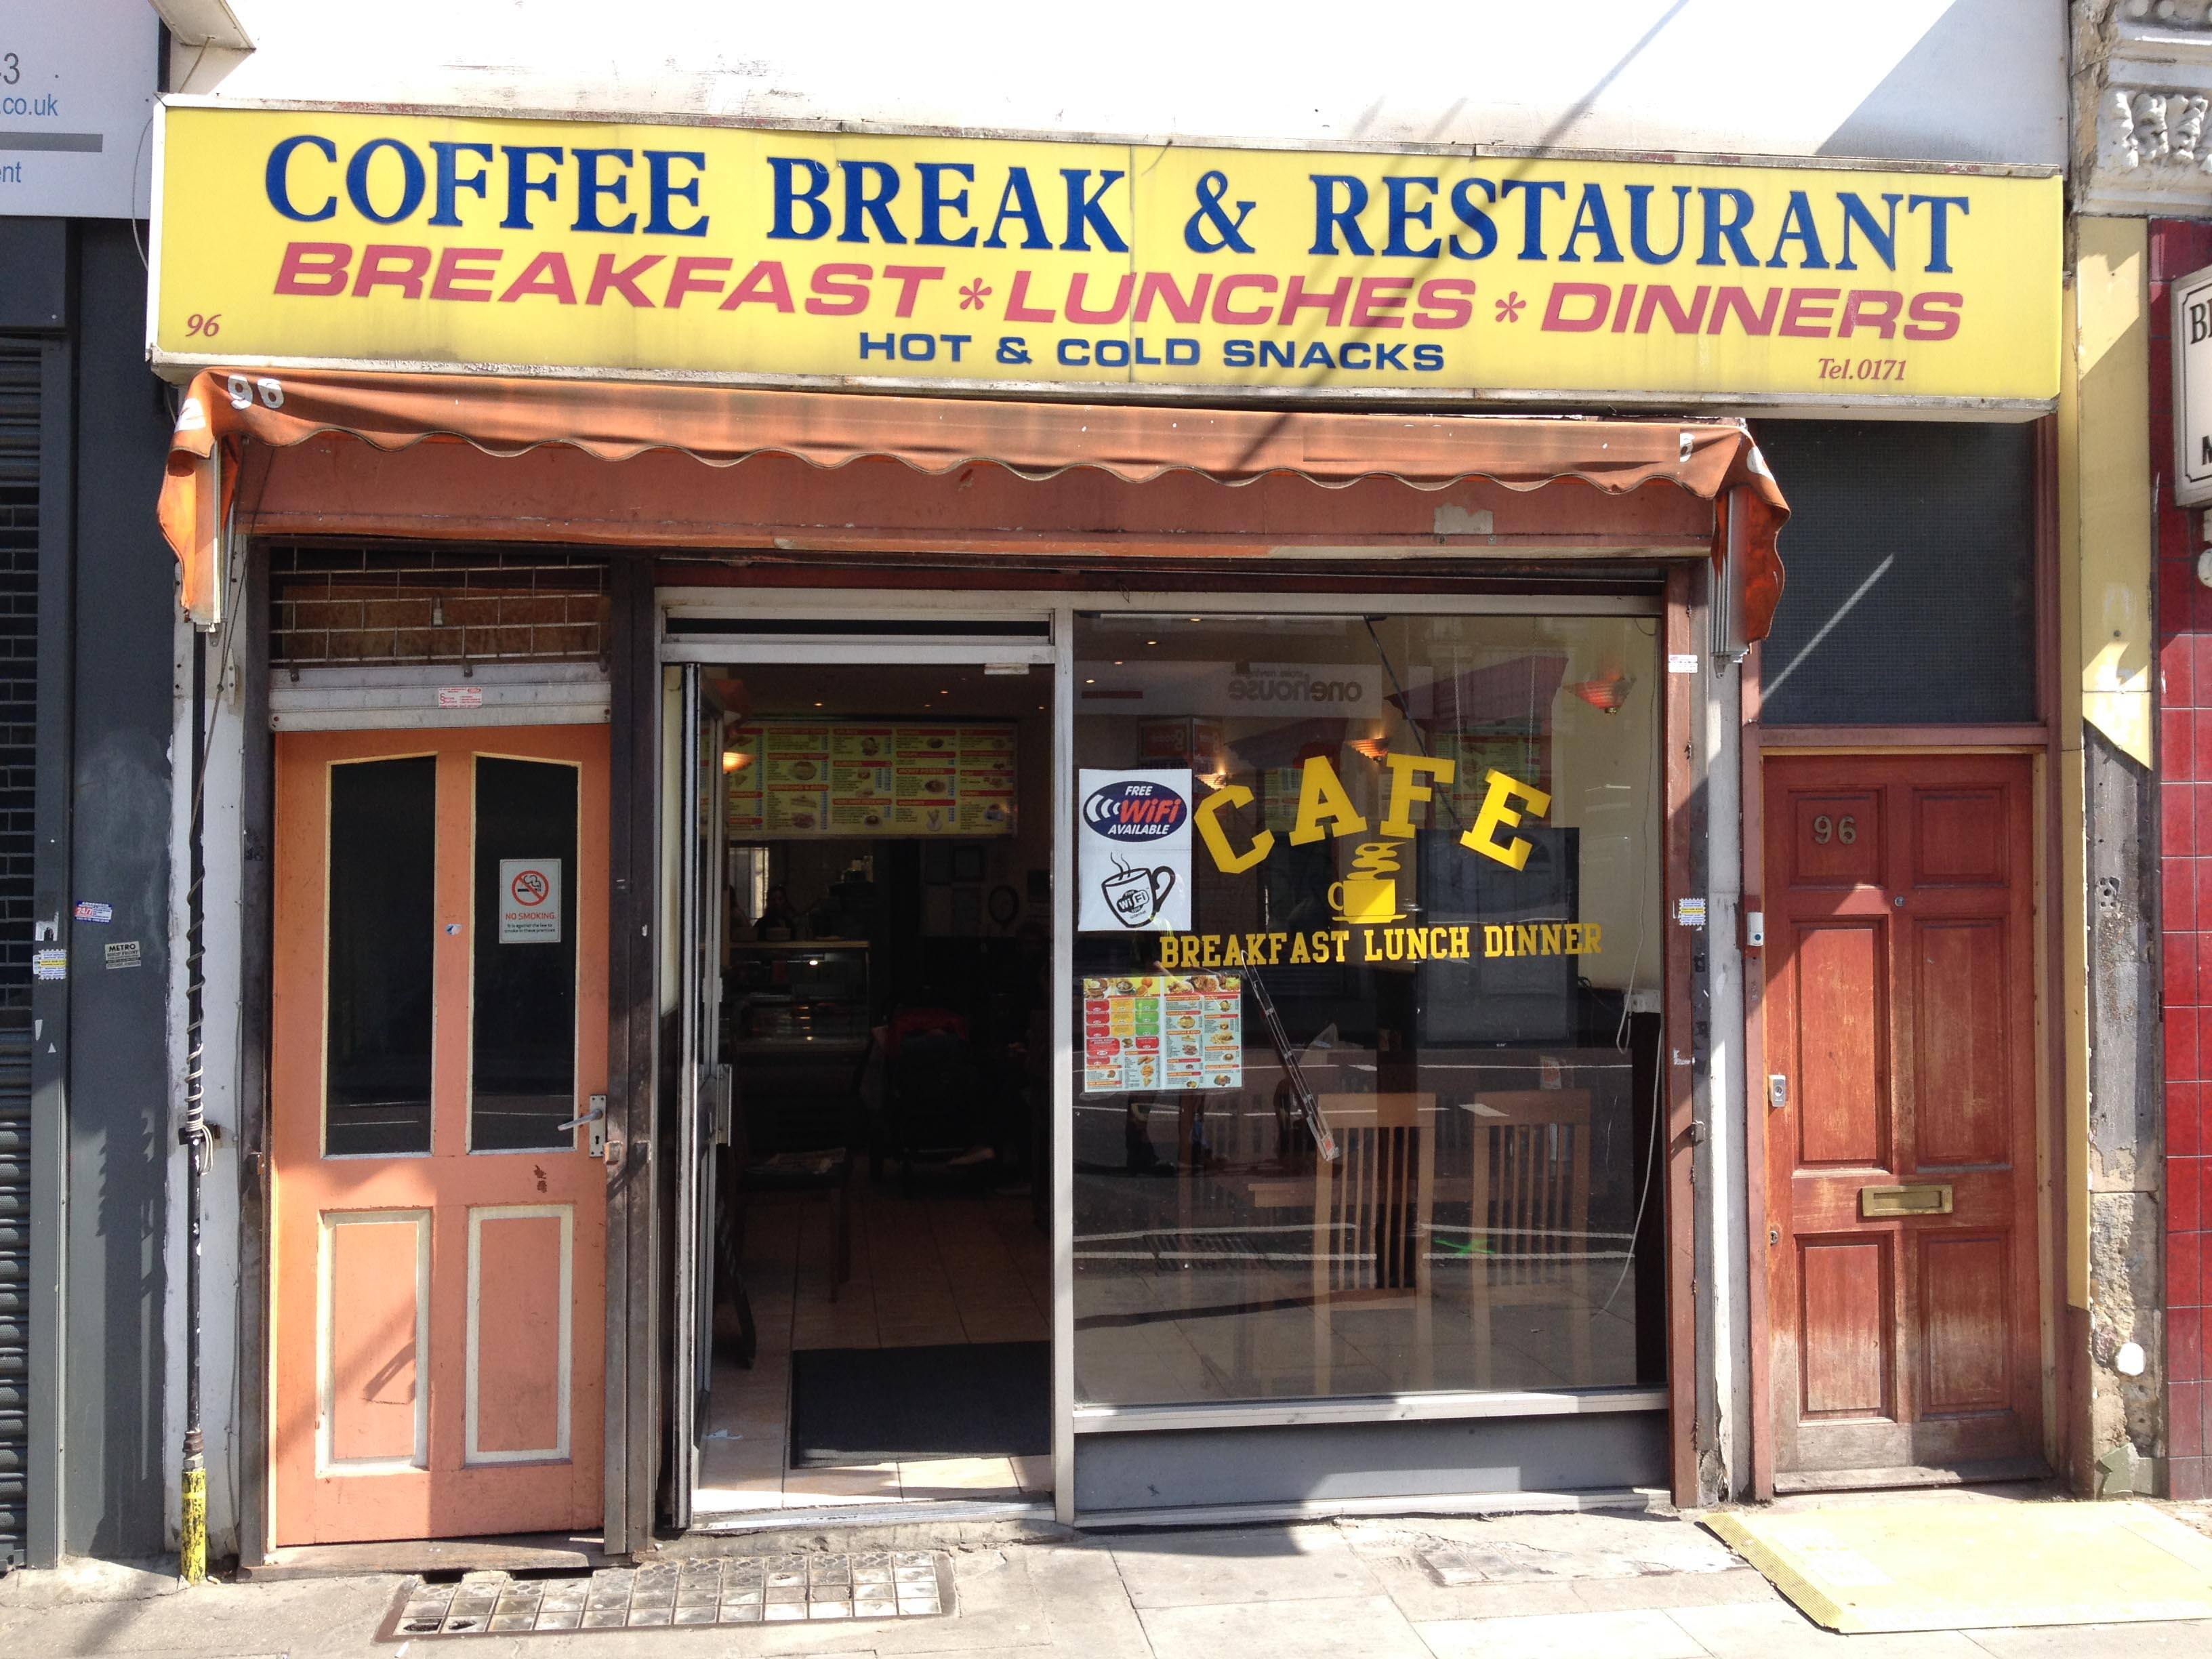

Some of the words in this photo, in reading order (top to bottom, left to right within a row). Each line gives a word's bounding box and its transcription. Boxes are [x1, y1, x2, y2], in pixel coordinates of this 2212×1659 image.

[0, 52, 20, 85] 3
[0, 94, 59, 117] co.uk
[0, 161, 22, 184] nt
[265, 135, 710, 237] COFFEE
[766, 156, 1130, 253] BREAK
[1185, 170, 1256, 253] &
[1309, 174, 1970, 274] RESTAURANT
[274, 241, 946, 319] BREAKFAST
[1003, 270, 1477, 329] LUNCHES
[1540, 282, 1964, 341] DINNERS
[186, 314, 222, 337] 96
[860, 332, 972, 362] HOT
[996, 336, 1033, 365] &
[1057, 337, 1200, 367] COLD
[1224, 339, 1444, 371] SNACKS
[228, 374, 284, 409] 96
[1124, 785, 1153, 796] FREE
[1120, 798, 1182, 824] WiFi
[1194, 753, 1551, 874] CAFE
[1107, 824, 1170, 835] AVAILABLE
[1813, 815, 1858, 844] 96
[505, 912, 517, 920] NO
[518, 912, 554, 920] SMOKING
[108, 943, 136, 952] METRO
[1159, 929, 1349, 969] BREAKFAST
[1364, 926, 1471, 962] LUNCH
[1483, 922, 1603, 958] DINNER
